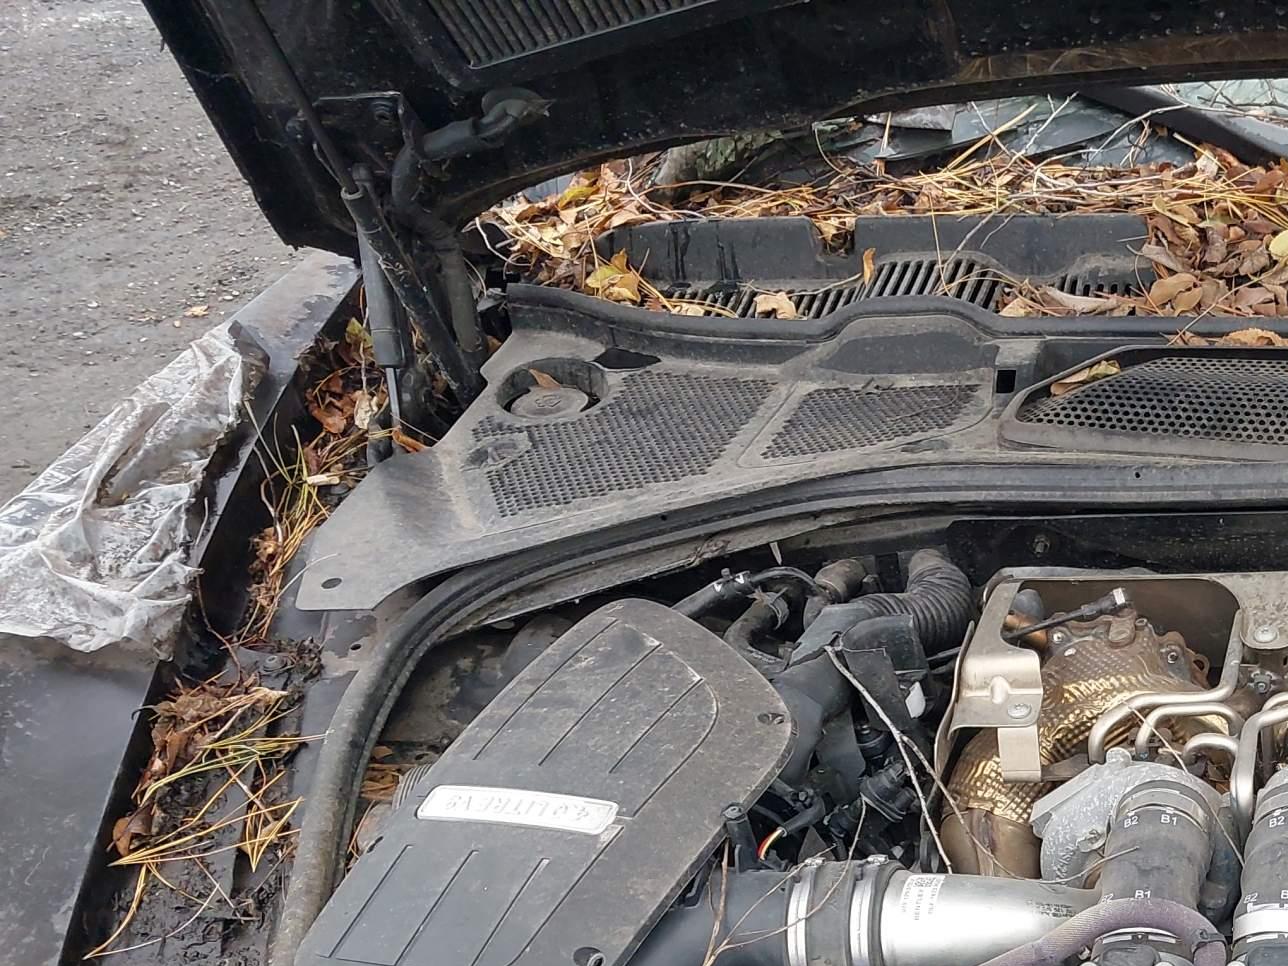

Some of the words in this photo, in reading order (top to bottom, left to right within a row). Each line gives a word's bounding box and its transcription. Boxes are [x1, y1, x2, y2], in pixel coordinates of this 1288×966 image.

[482, 797, 548, 816] LITRE
[1123, 815, 1139, 829] B2
[1160, 813, 1178, 826] B1
[1269, 816, 1285, 828] B2
[1134, 889, 1151, 900] B1
[1243, 893, 1259, 904] B2
